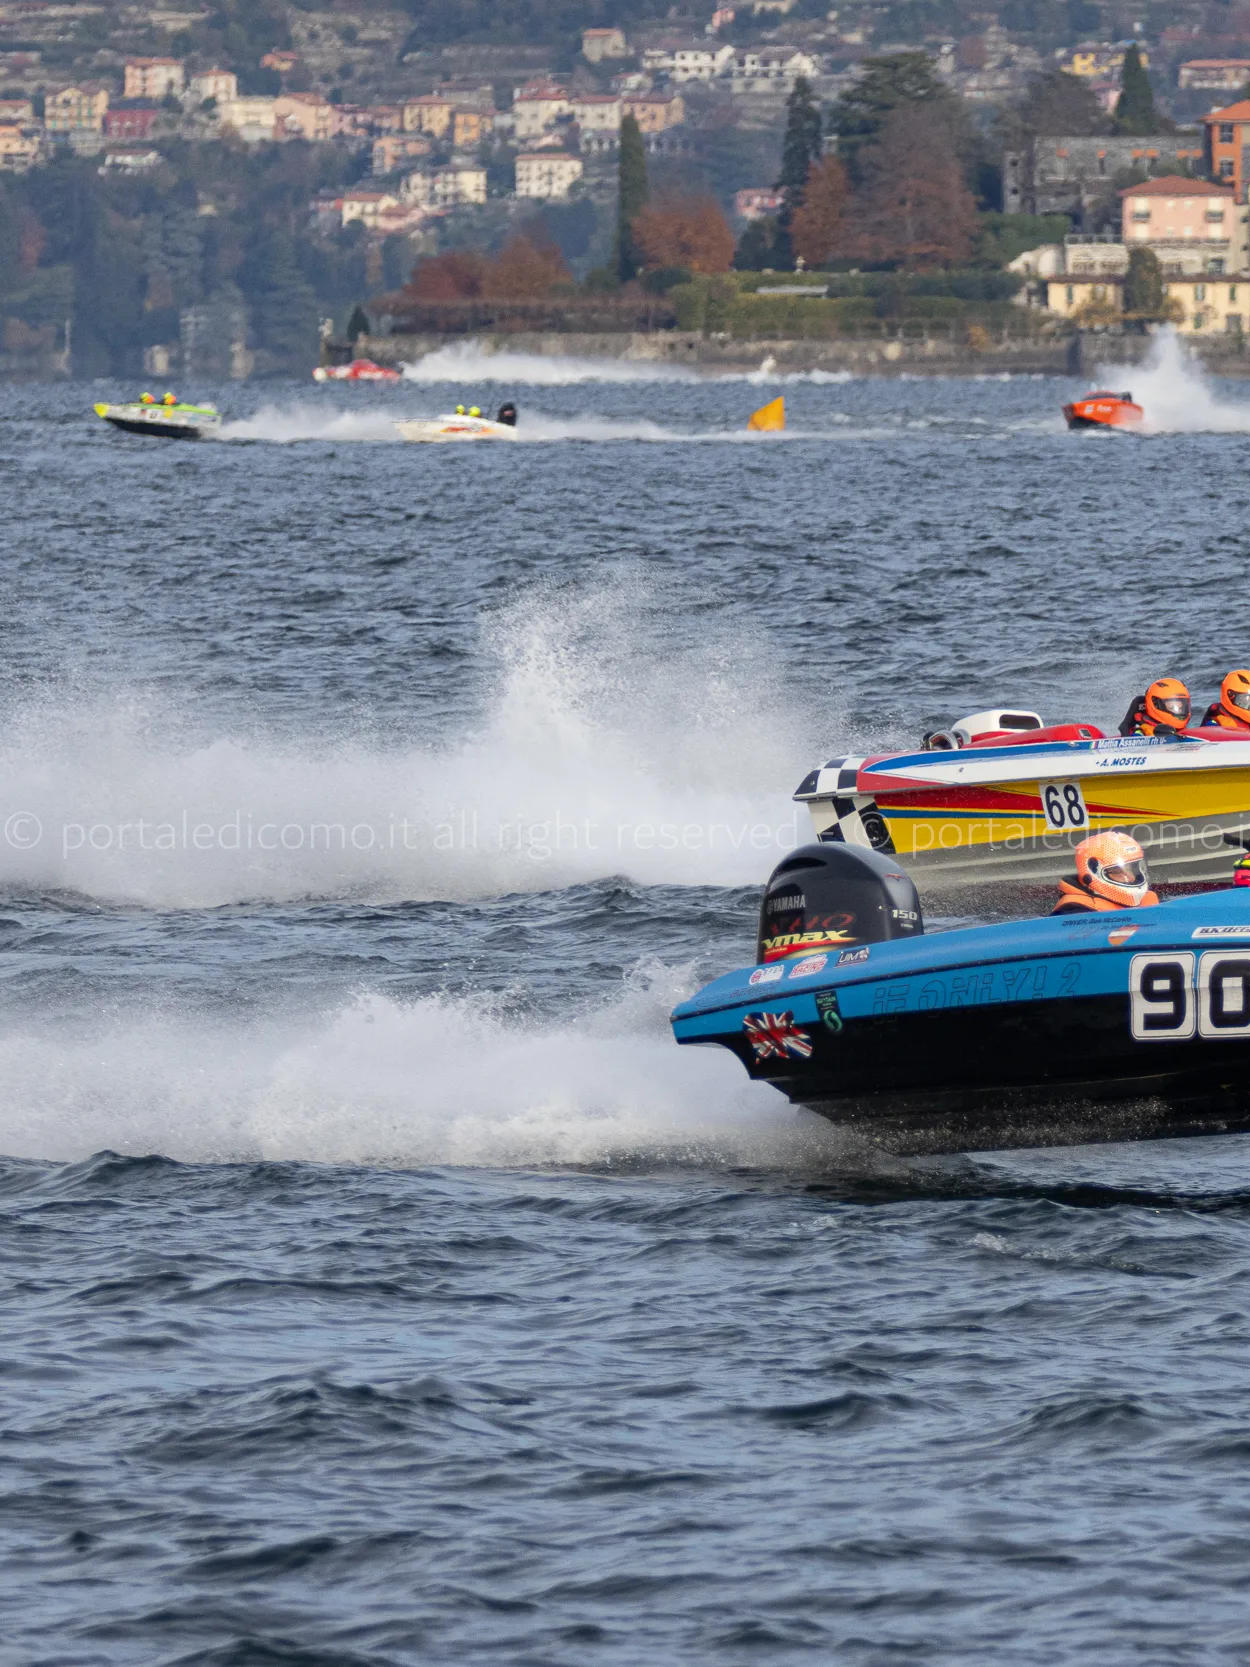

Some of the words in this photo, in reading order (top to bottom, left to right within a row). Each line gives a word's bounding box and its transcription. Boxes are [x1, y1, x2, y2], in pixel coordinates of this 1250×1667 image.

[1111, 757, 1147, 766] MOSTES
[1045, 784, 1085, 828] 68
[773, 895, 806, 912] YAMAHA
[892, 909, 917, 920] 150
